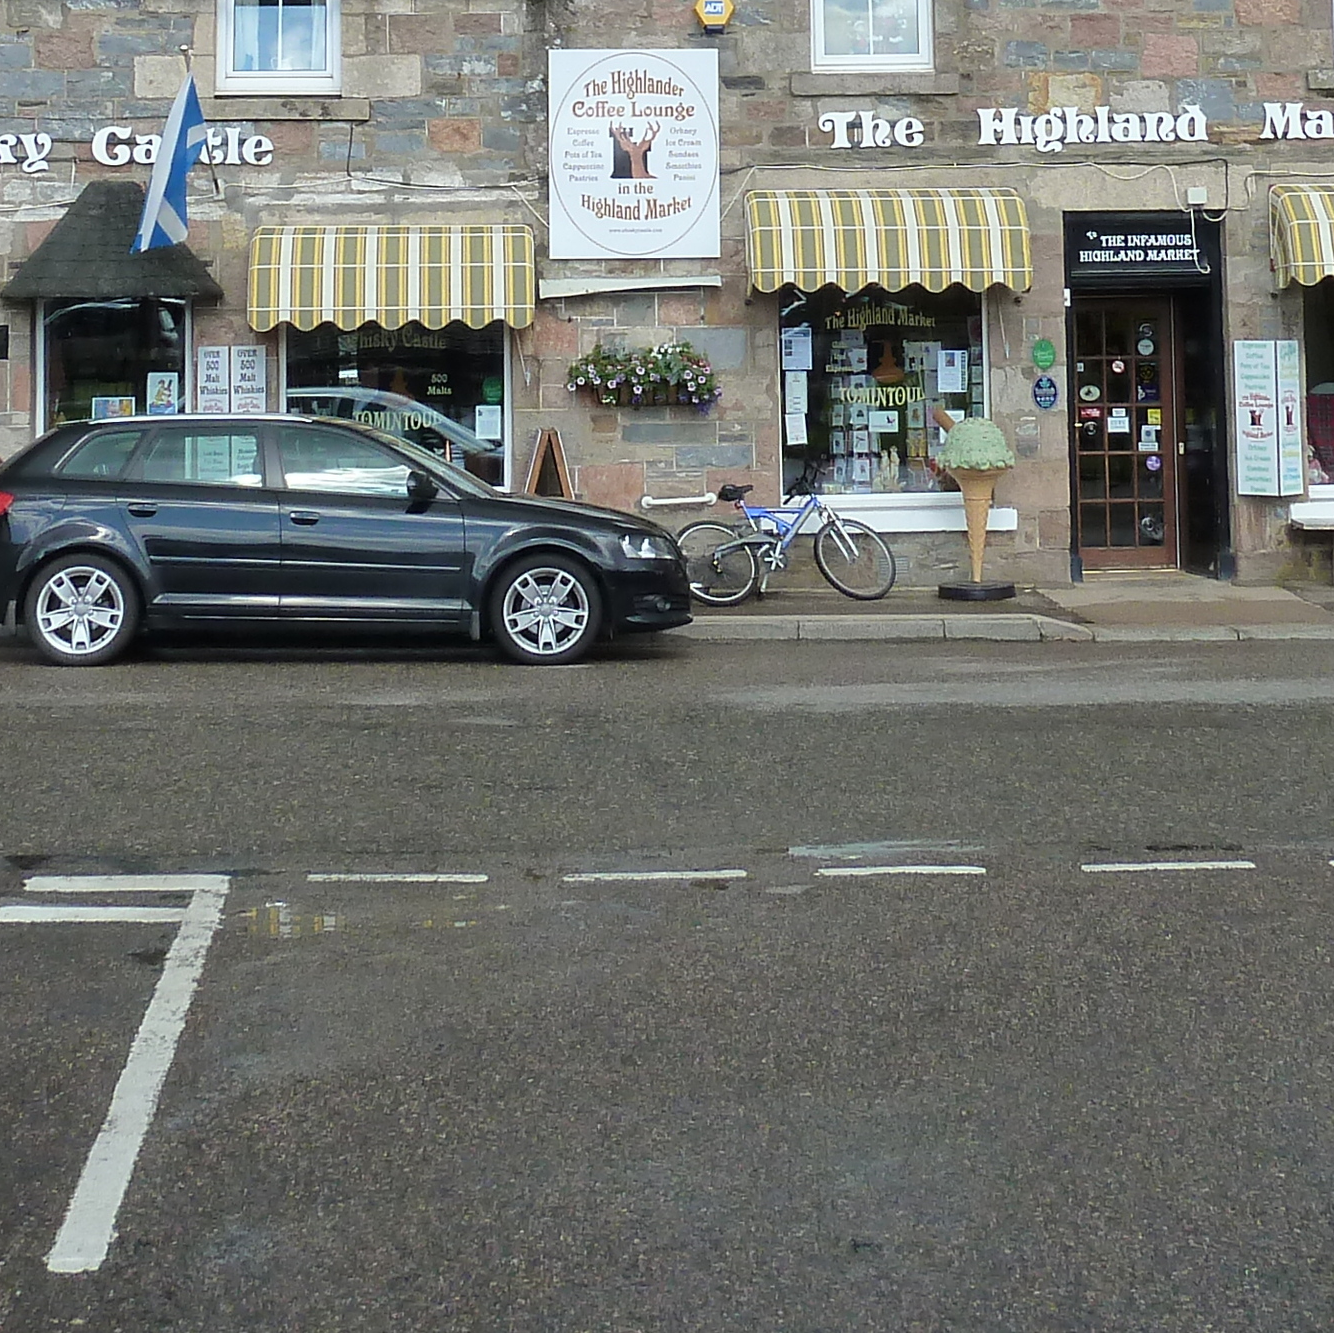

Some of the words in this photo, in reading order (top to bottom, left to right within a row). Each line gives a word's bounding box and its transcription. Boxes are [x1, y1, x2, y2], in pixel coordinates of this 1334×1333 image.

[705, 3, 723, 13] ADT
[584, 79, 608, 97] The
[610, 69, 684, 99] Highlander
[573, 101, 625, 117] Coffee
[631, 101, 695, 121] Lounge
[818, 111, 925, 149] The
[977, 106, 1209, 153] Highland
[91, 126, 274, 166] Catle
[618, 183, 630, 194] in
[634, 182, 653, 194] the
[581, 194, 641, 220] Highland
[645, 196, 691, 220] Market
[1100, 235, 1125, 247] THE
[1128, 234, 1192, 246] INFAMOUS
[1079, 251, 1144, 262] HIGHLAND
[1146, 249, 1200, 261] MARKET
[825, 312, 845, 330] The
[847, 303, 896, 331] Highland
[897, 309, 937, 328] Market
[402, 324, 447, 349] Castle
[205, 373, 220, 383] Malt
[239, 373, 256, 382] Malt
[431, 373, 448, 383] 500
[200, 386, 228, 395] Whiskies
[234, 386, 264, 394] Whiskies
[427, 385, 452, 395] Malts
[839, 386, 925, 407] TOMINTOUL
